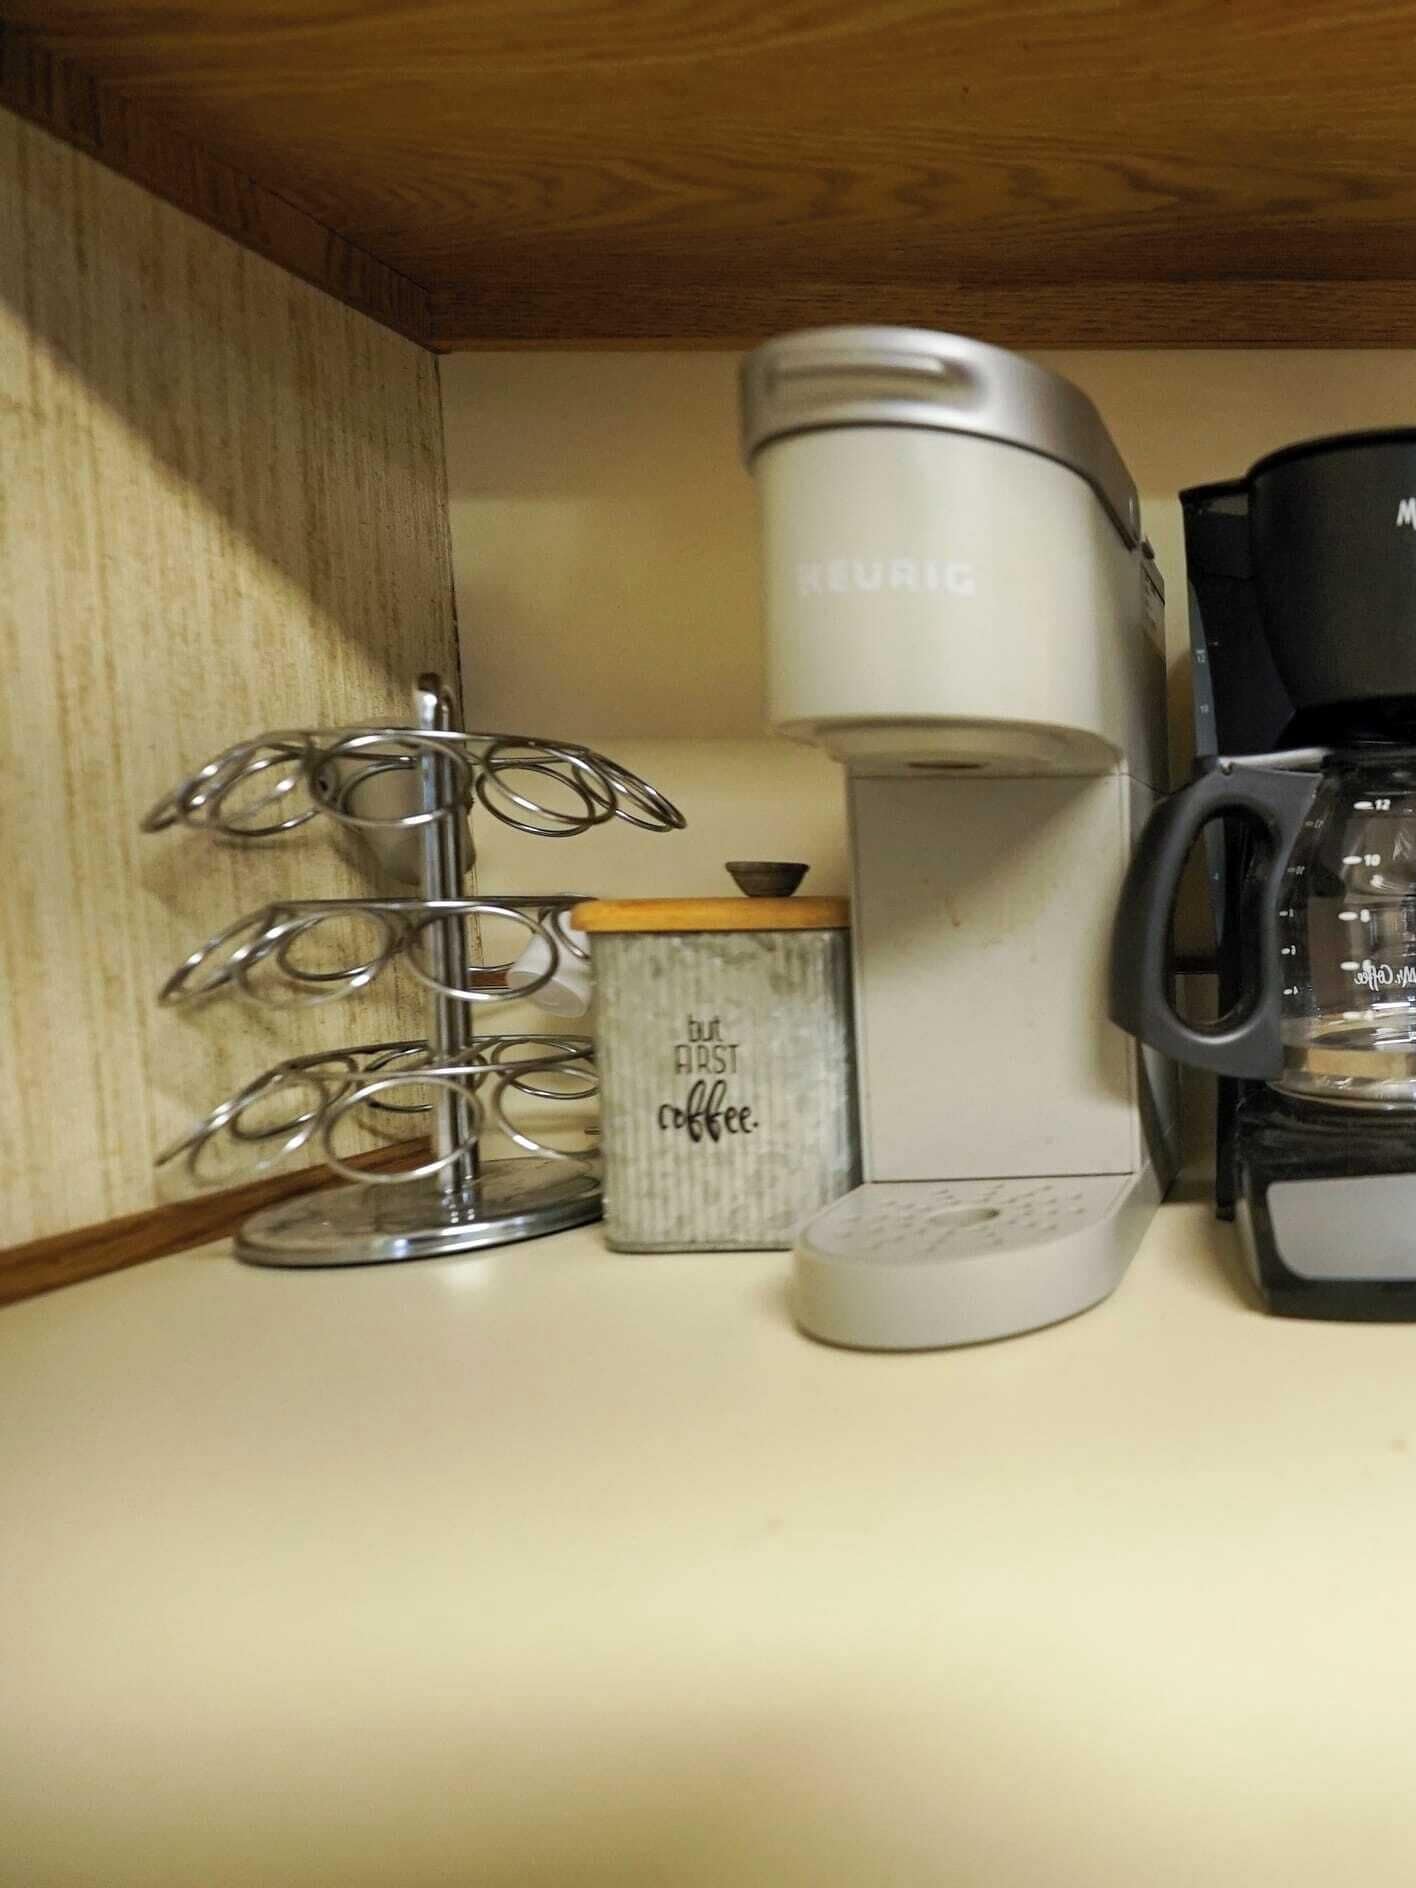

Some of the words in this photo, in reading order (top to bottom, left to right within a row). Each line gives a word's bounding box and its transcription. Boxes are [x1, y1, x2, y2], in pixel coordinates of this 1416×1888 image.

[798, 558, 976, 597] KEURIG
[1374, 798, 1391, 811] 12
[1363, 853, 1381, 867] 10
[688, 1014, 723, 1042] but
[674, 1044, 740, 1074] FIRST
[657, 1079, 760, 1142] coffee.
